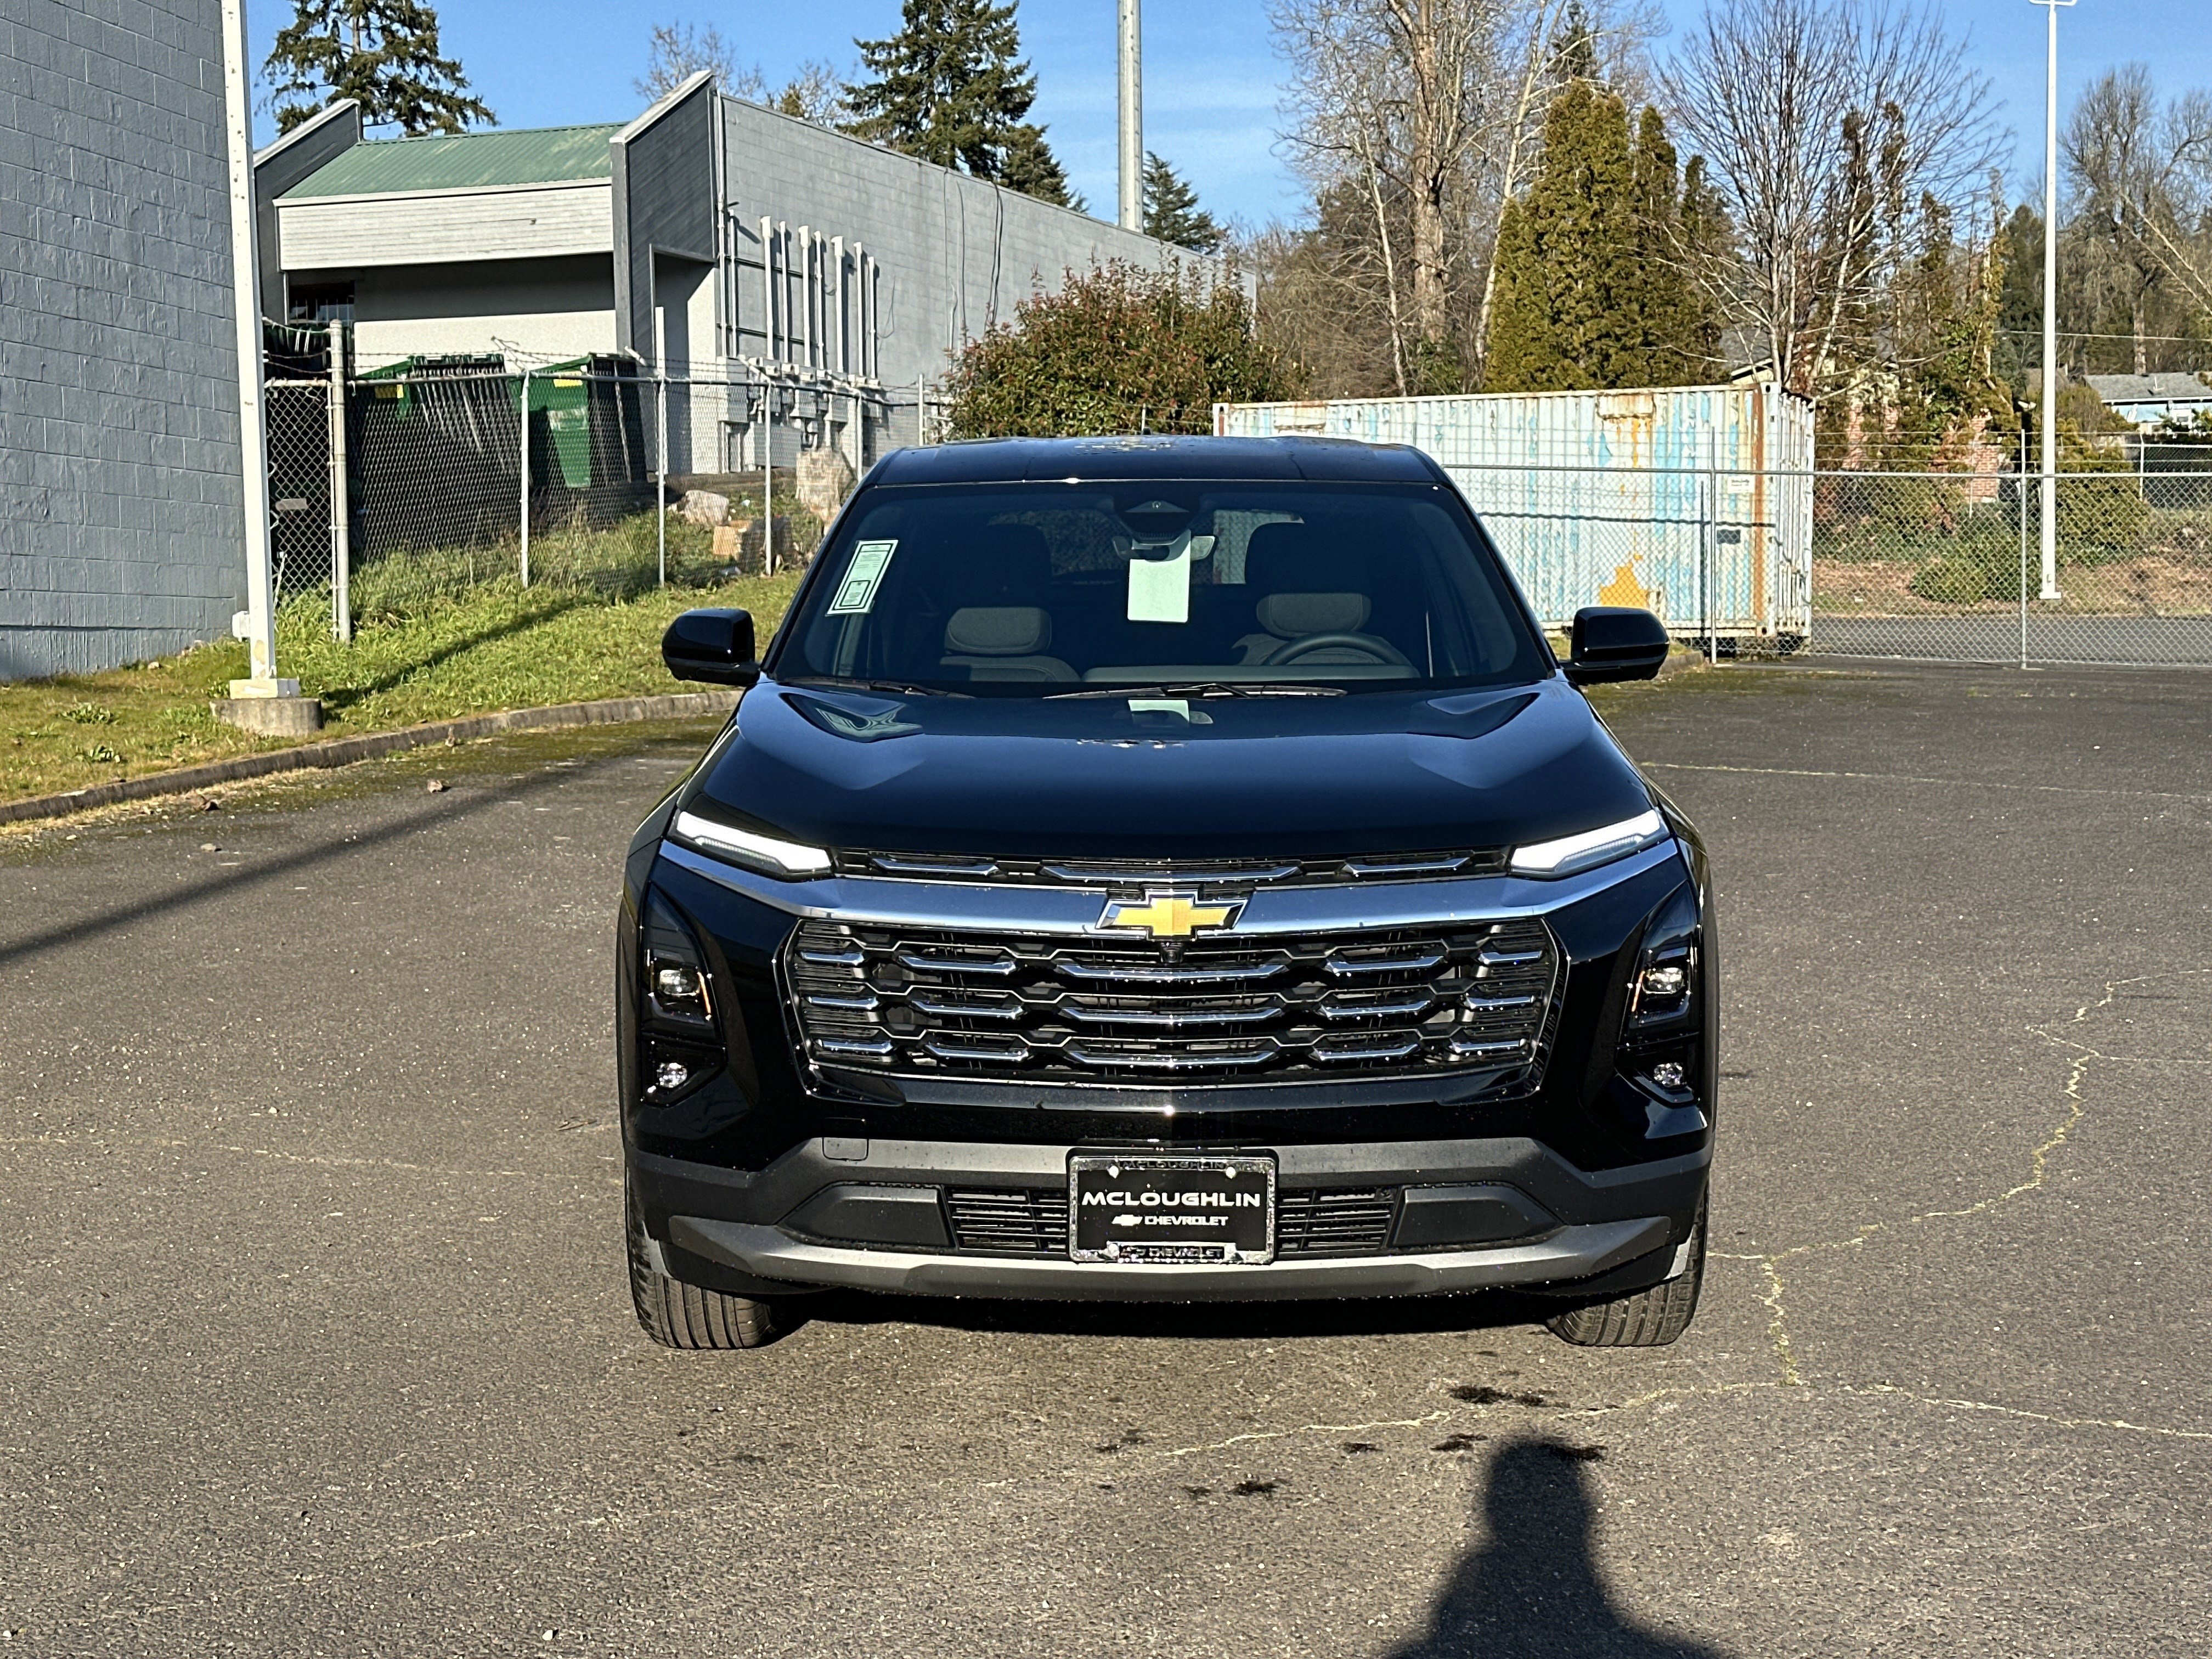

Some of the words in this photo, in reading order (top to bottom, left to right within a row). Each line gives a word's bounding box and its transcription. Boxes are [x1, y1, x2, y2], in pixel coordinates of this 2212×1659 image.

[1122, 1160, 1225, 1169] MCLOUGHLIN
[1082, 1192, 1260, 1207] MCLOUGHLIN
[1144, 1215, 1229, 1226] CHEVROLET
